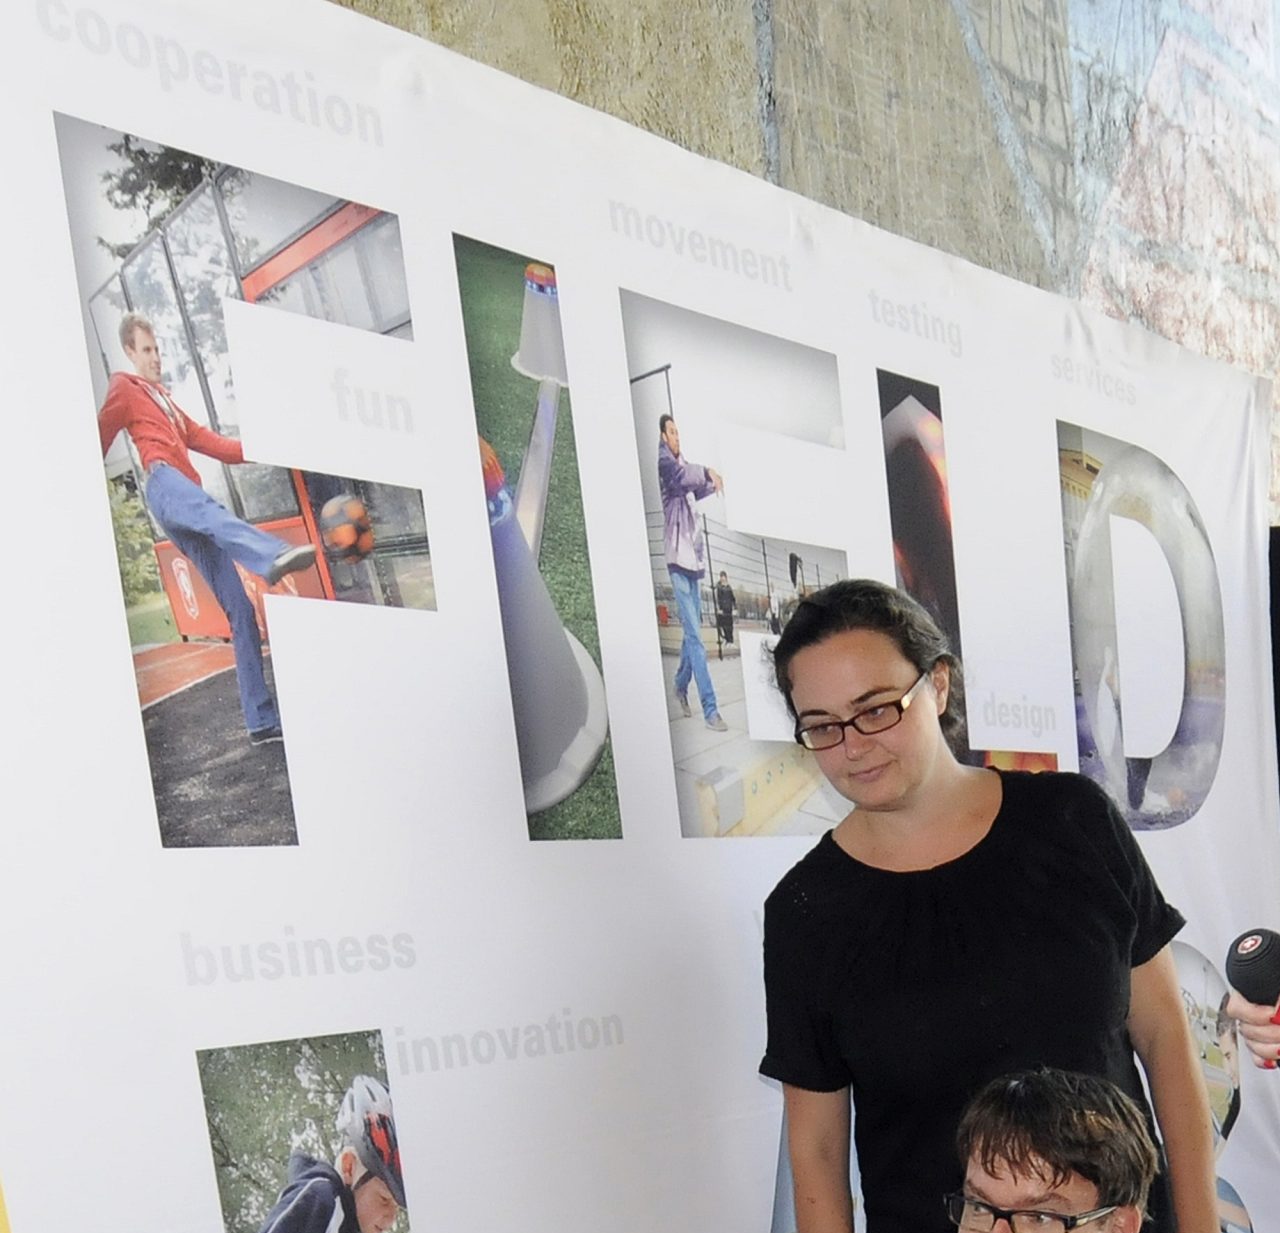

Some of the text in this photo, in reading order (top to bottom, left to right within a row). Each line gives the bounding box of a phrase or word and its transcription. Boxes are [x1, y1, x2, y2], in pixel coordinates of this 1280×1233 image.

[35, 0, 384, 147] cooperation
[608, 199, 793, 292] movement
[868, 288, 963, 358] testing
[329, 367, 414, 433] fun
[1049, 352, 1138, 406] services
[983, 691, 1057, 739] design
[179, 925, 418, 987] business
[394, 1007, 626, 1076] innovation
